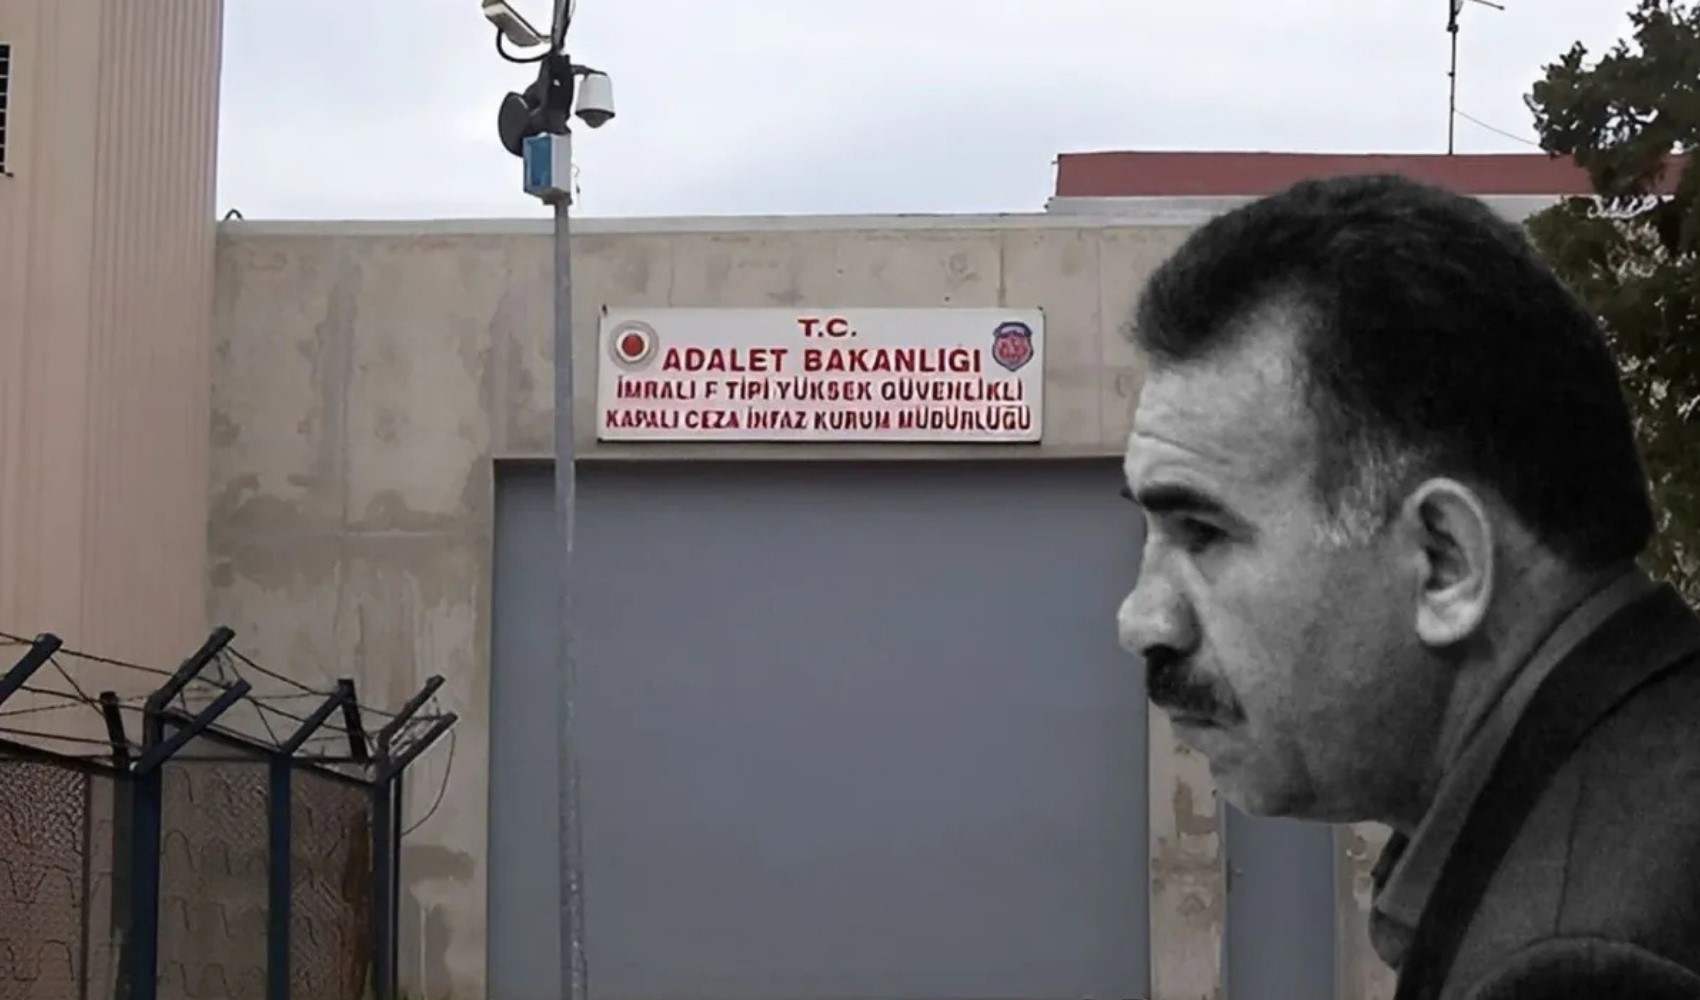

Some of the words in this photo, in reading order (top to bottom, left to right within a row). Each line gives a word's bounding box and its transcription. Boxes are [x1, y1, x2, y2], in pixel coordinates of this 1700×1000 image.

[798, 318, 857, 338] T.C.
[662, 347, 788, 372] ADALET
[685, 410, 740, 429] CEZA
